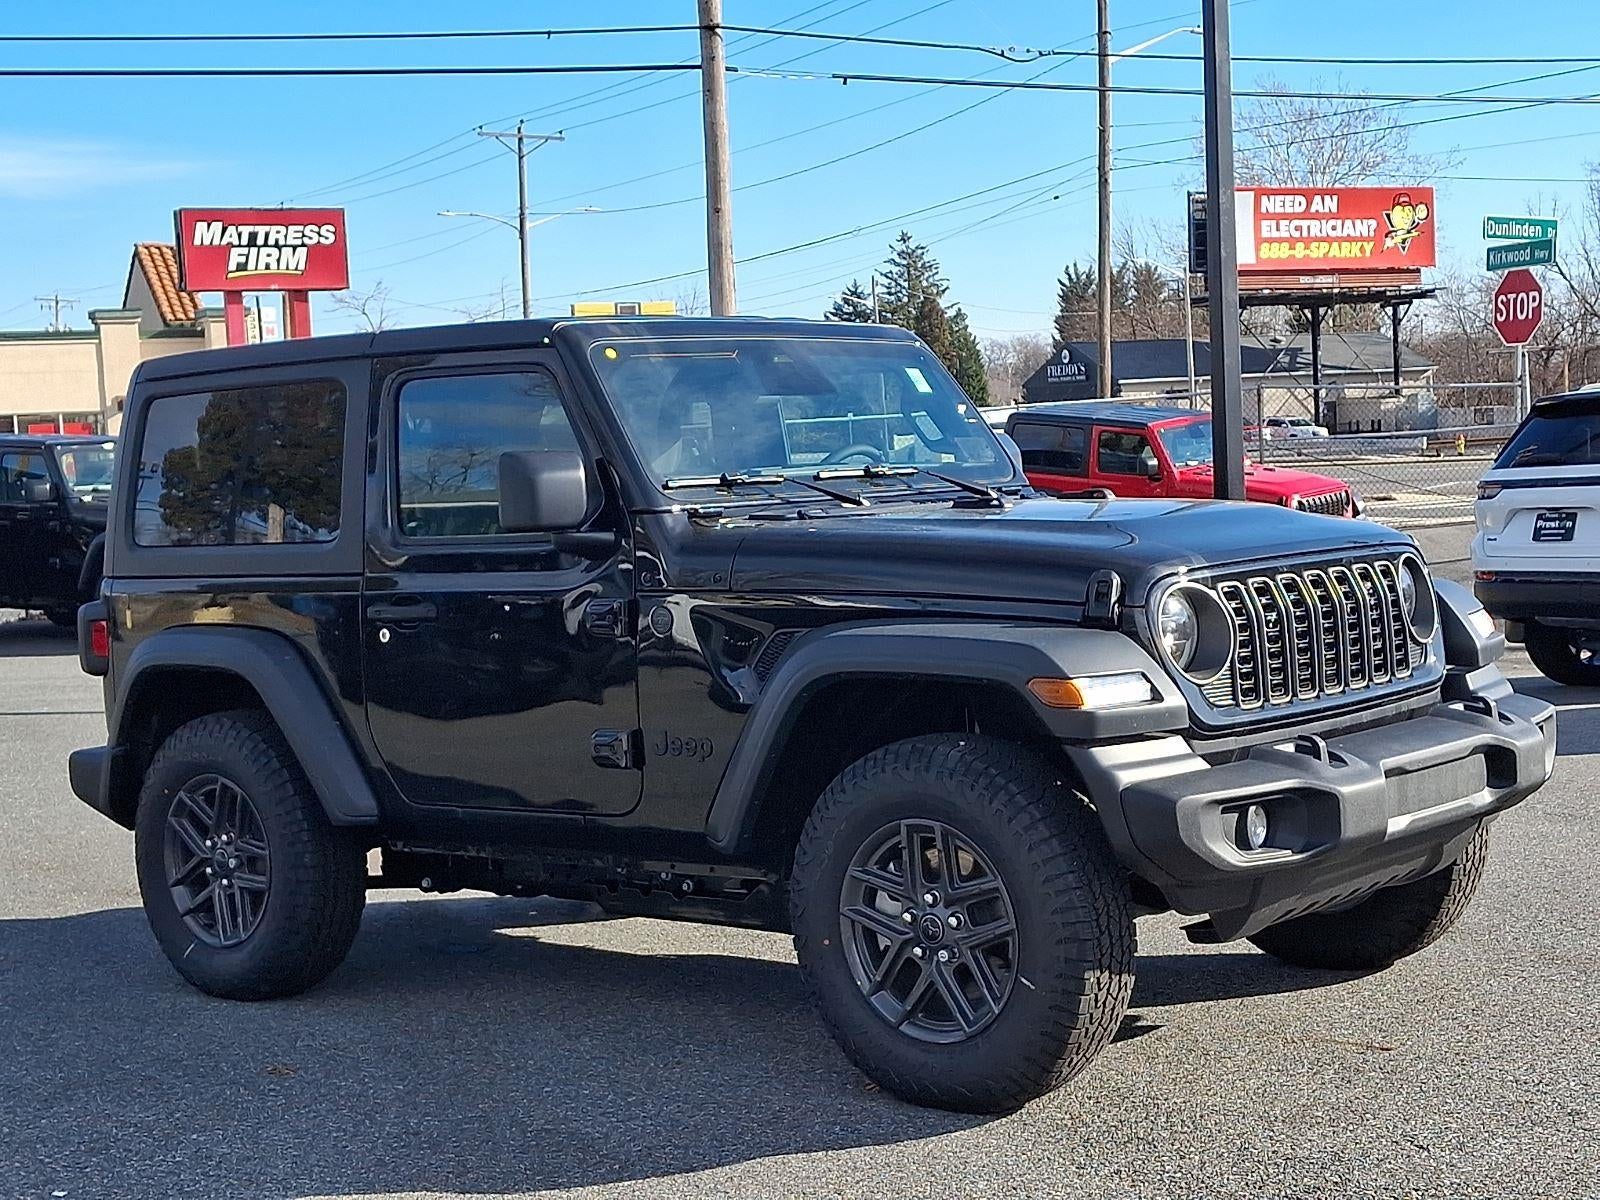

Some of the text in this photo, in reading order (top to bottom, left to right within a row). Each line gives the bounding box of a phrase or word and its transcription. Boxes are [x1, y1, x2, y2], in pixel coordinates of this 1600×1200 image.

[1260, 195, 1338, 213] NEED AN
[194, 221, 336, 246] MATTRESS
[1260, 219, 1377, 238] ELECTRICIAN?
[1487, 220, 1543, 237] Dunlinden
[227, 246, 308, 271] FIRM
[1260, 241, 1374, 259] 888-8-SPARKY
[1489, 246, 1549, 266] Kirkwood Hwy
[1496, 291, 1540, 322] STOP
[1047, 363, 1085, 377] FREDDY'S
[655, 730, 714, 763] Jeep
